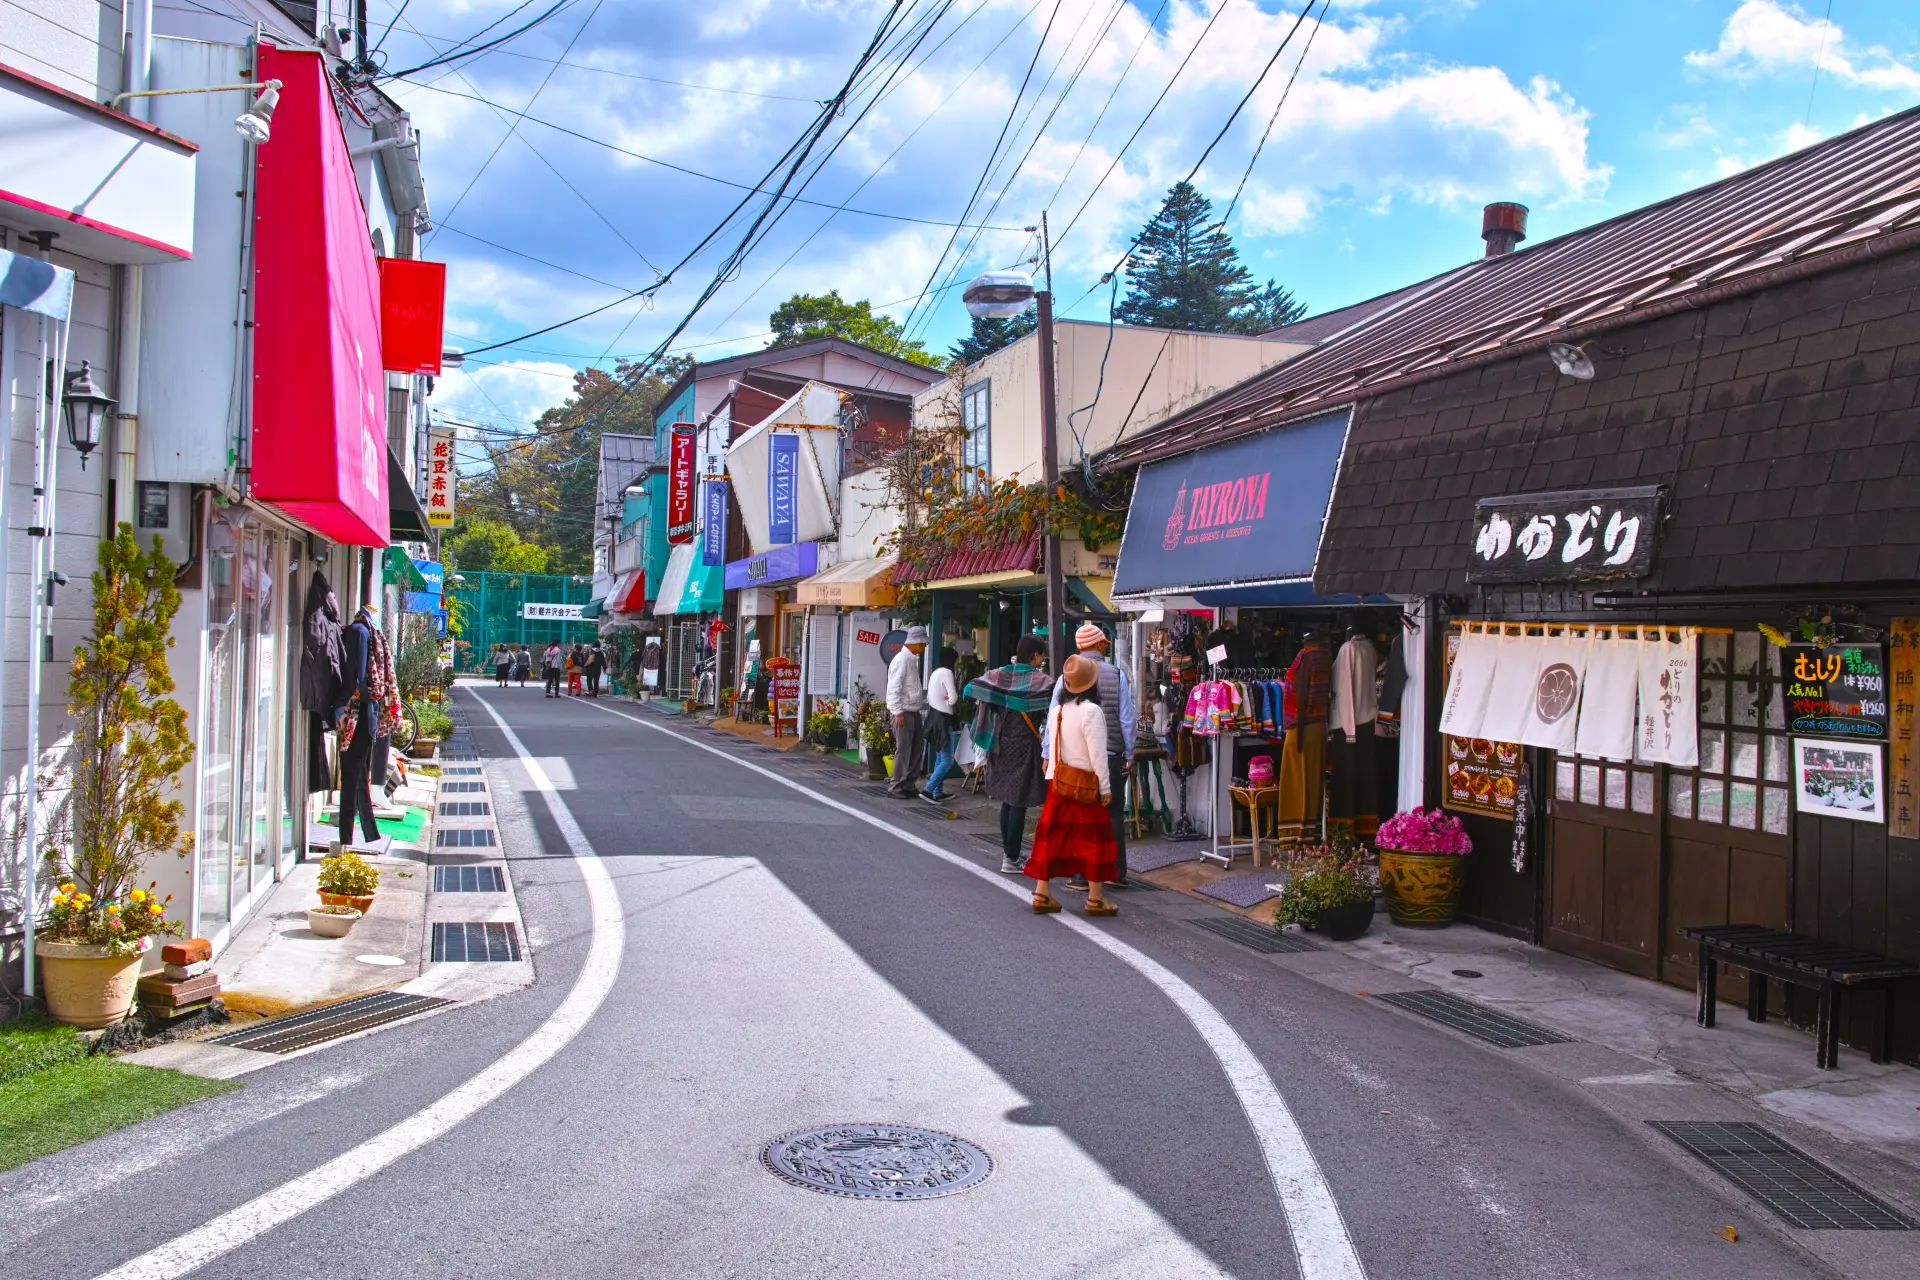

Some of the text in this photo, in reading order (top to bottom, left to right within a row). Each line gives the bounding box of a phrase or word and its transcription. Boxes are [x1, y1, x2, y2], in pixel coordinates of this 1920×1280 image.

[431, 441, 449, 508] 花豆赤飯
[675, 437, 690, 522] アートギャラリー
[776, 452, 790, 525] SAWAYA
[711, 493, 720, 515] SHOP
[1187, 472, 1271, 531] TAYRONA
[669, 522, 693, 538] 軽井沢
[710, 523, 720, 555] COFFEE
[1475, 505, 1642, 567] わかどり
[858, 630, 879, 644] SALE
[1794, 652, 1841, 684] むしり
[1844, 648, 1862, 664] 当店
[1848, 661, 1880, 675] オリジナル
[1659, 669, 1674, 750] わかどり
[1643, 714, 1655, 751] 軽井沢
[1515, 784, 1529, 840] 営業中
